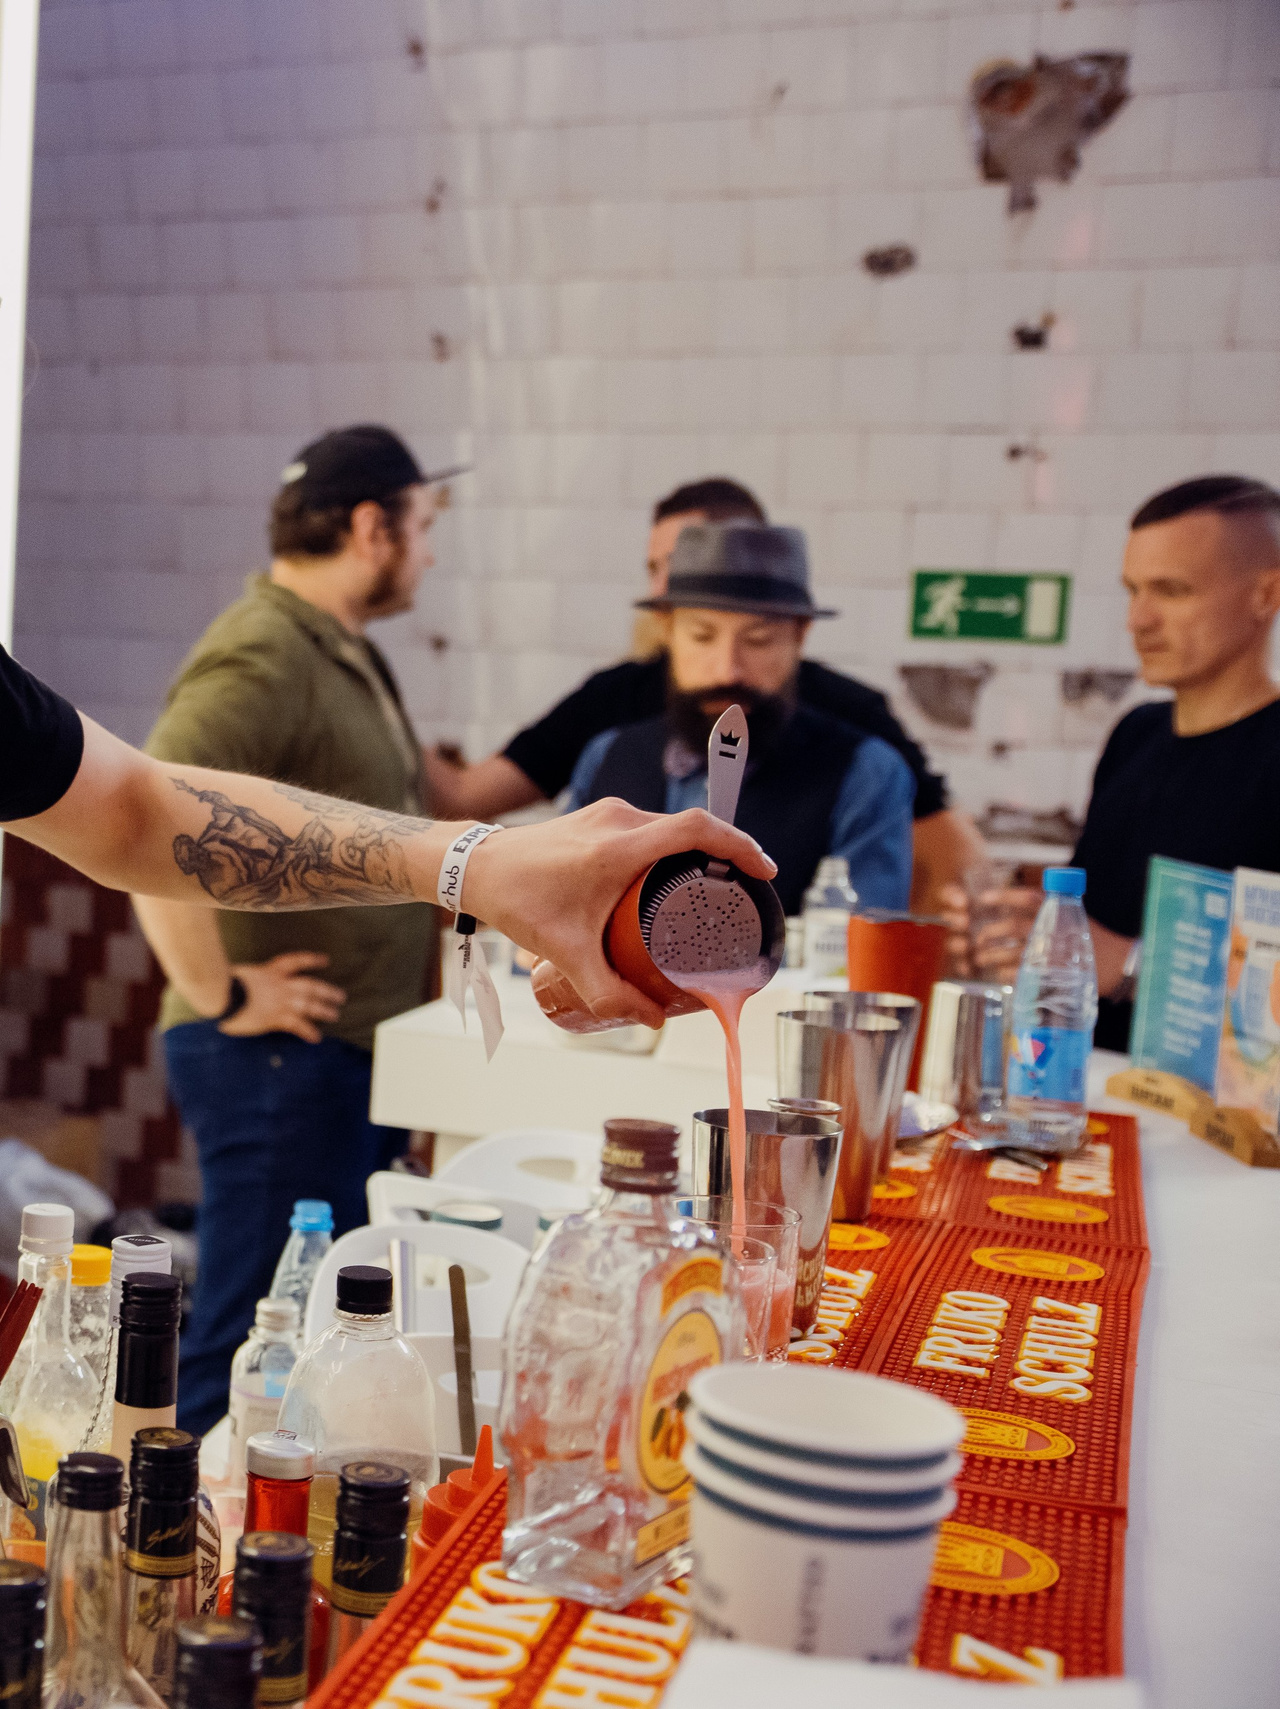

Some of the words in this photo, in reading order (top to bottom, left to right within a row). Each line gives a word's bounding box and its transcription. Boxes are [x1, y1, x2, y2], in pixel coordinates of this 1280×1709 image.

[452, 827, 491, 854] EXPO
[914, 1289, 1011, 1379] FRUKO
[1009, 1295, 1103, 1403] SCHULZ
